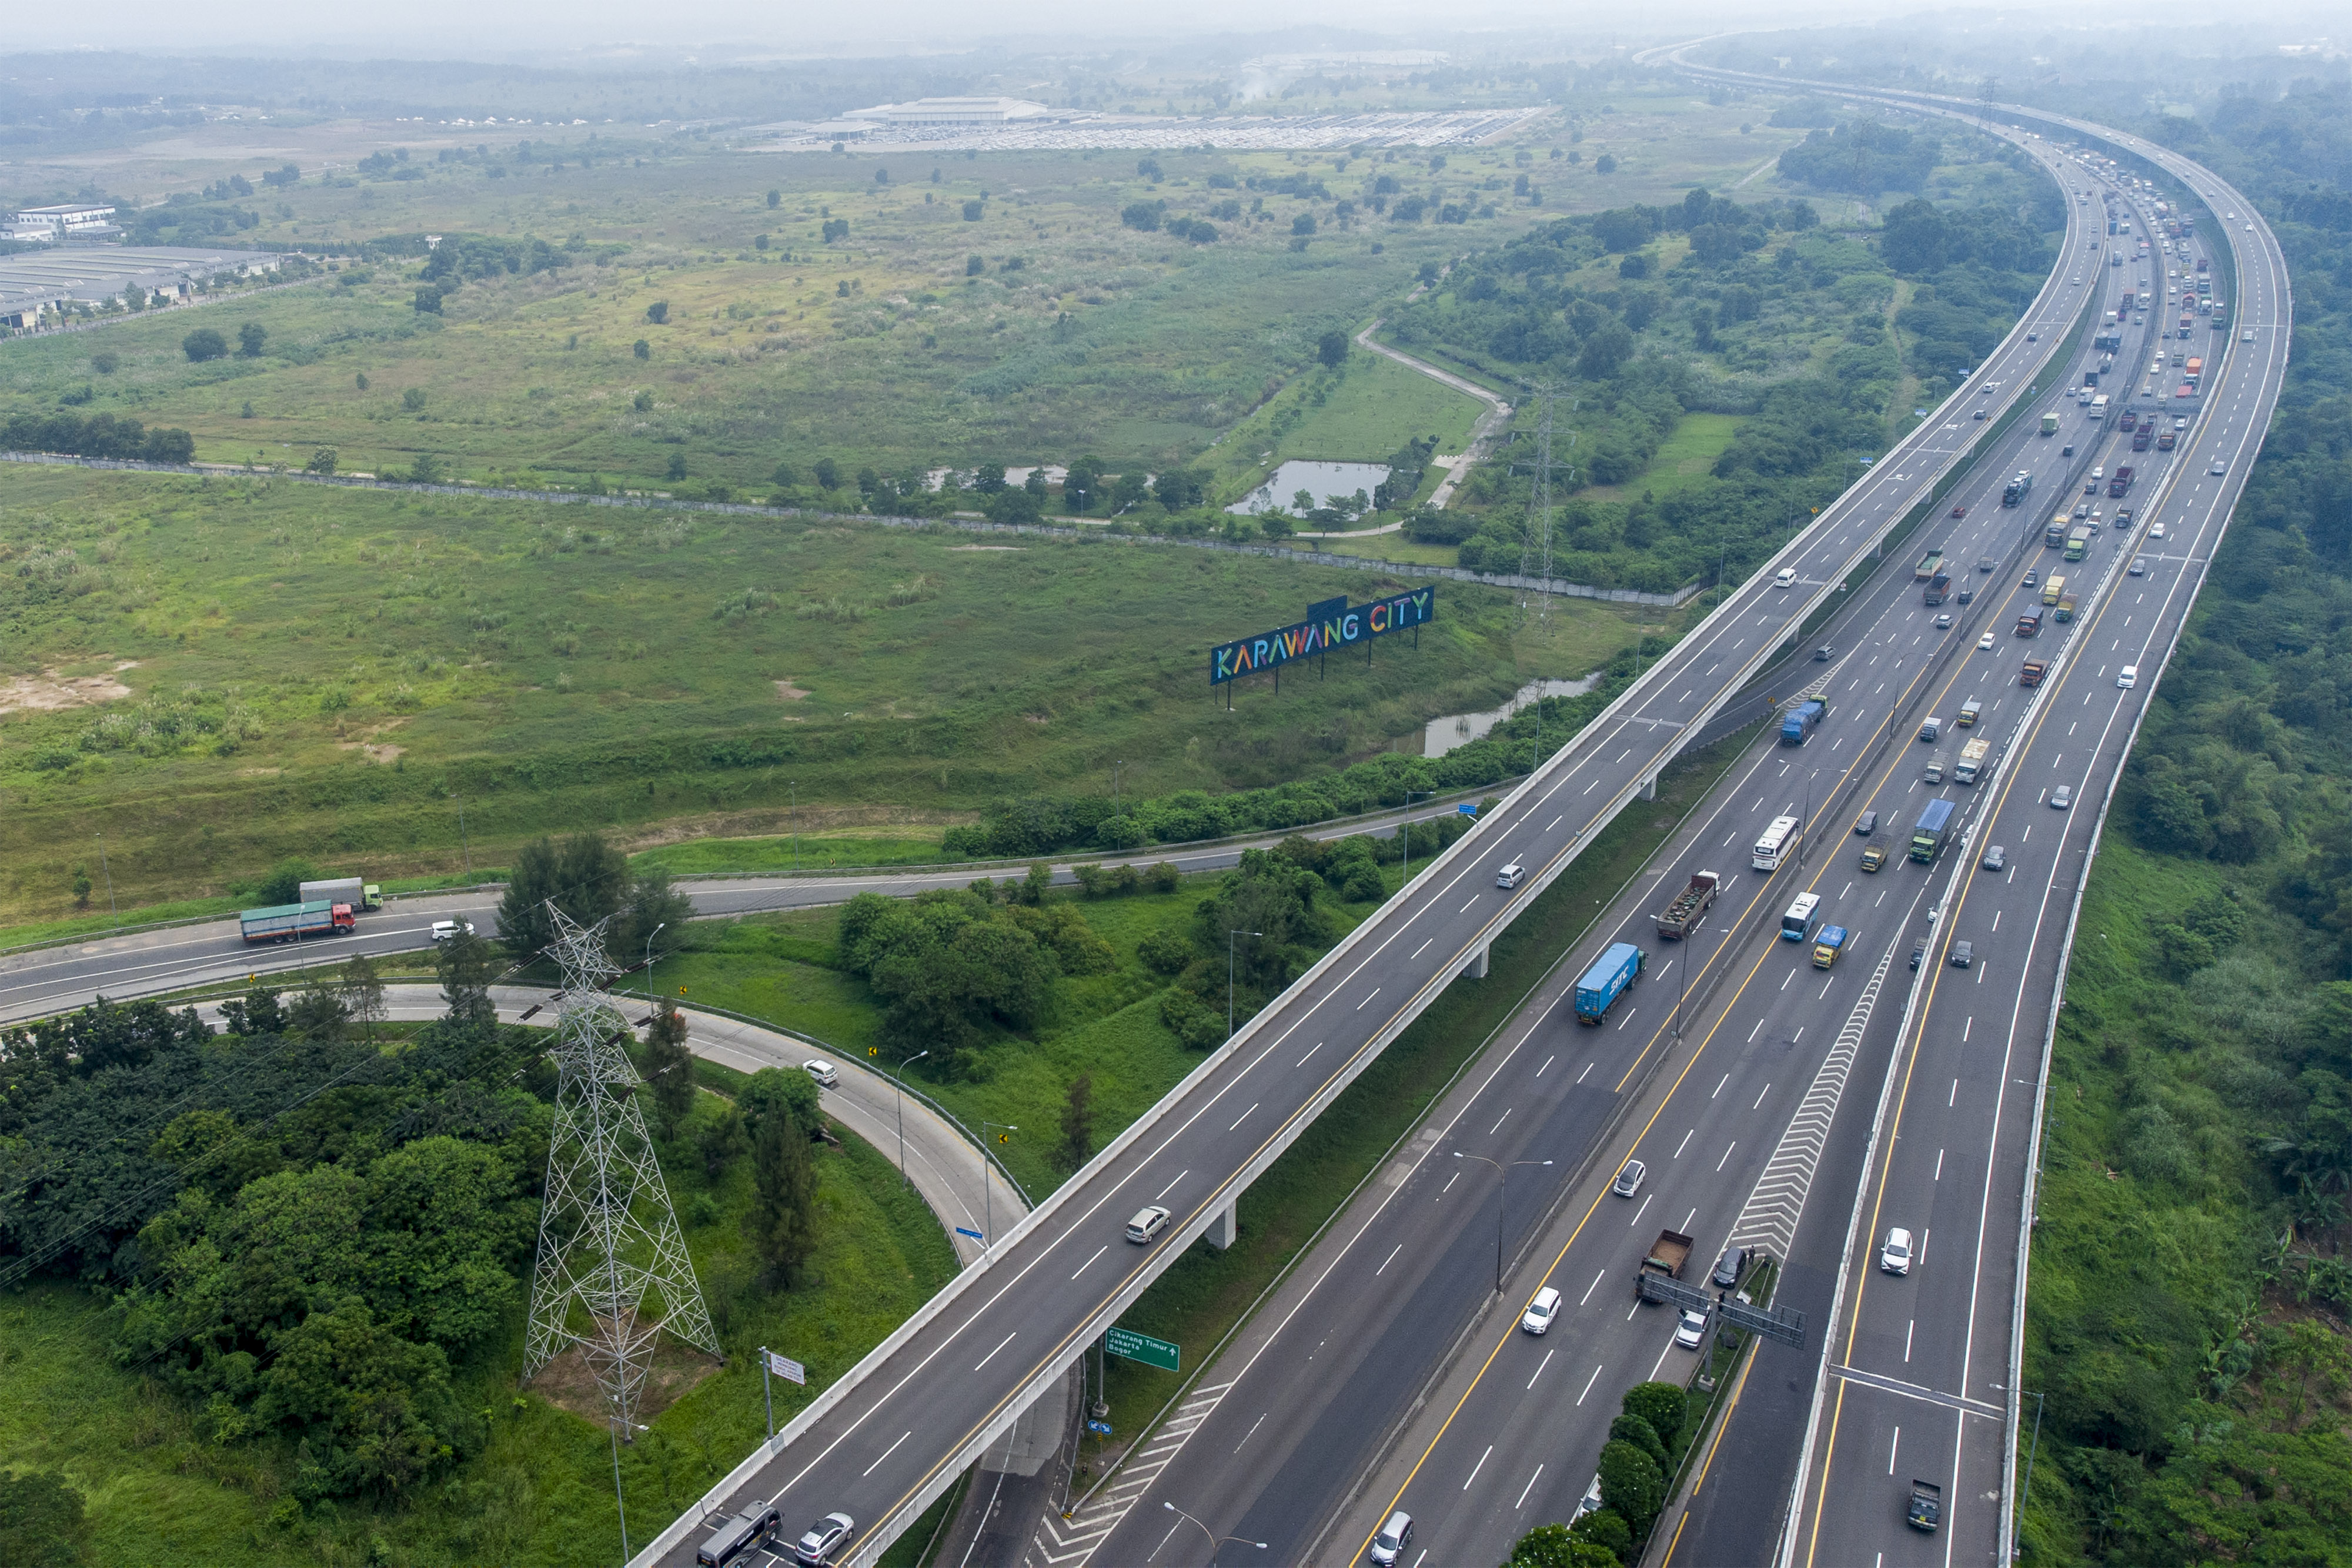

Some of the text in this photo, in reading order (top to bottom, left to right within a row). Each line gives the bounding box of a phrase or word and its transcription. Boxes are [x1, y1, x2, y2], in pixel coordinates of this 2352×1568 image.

[1218, 592, 1428, 678] KARAWANG CITY
[1109, 1330, 1168, 1351] Cikarang Timur
[1110, 1338, 1140, 1350] Jakarta
[1109, 1344, 1131, 1355] Bogor
